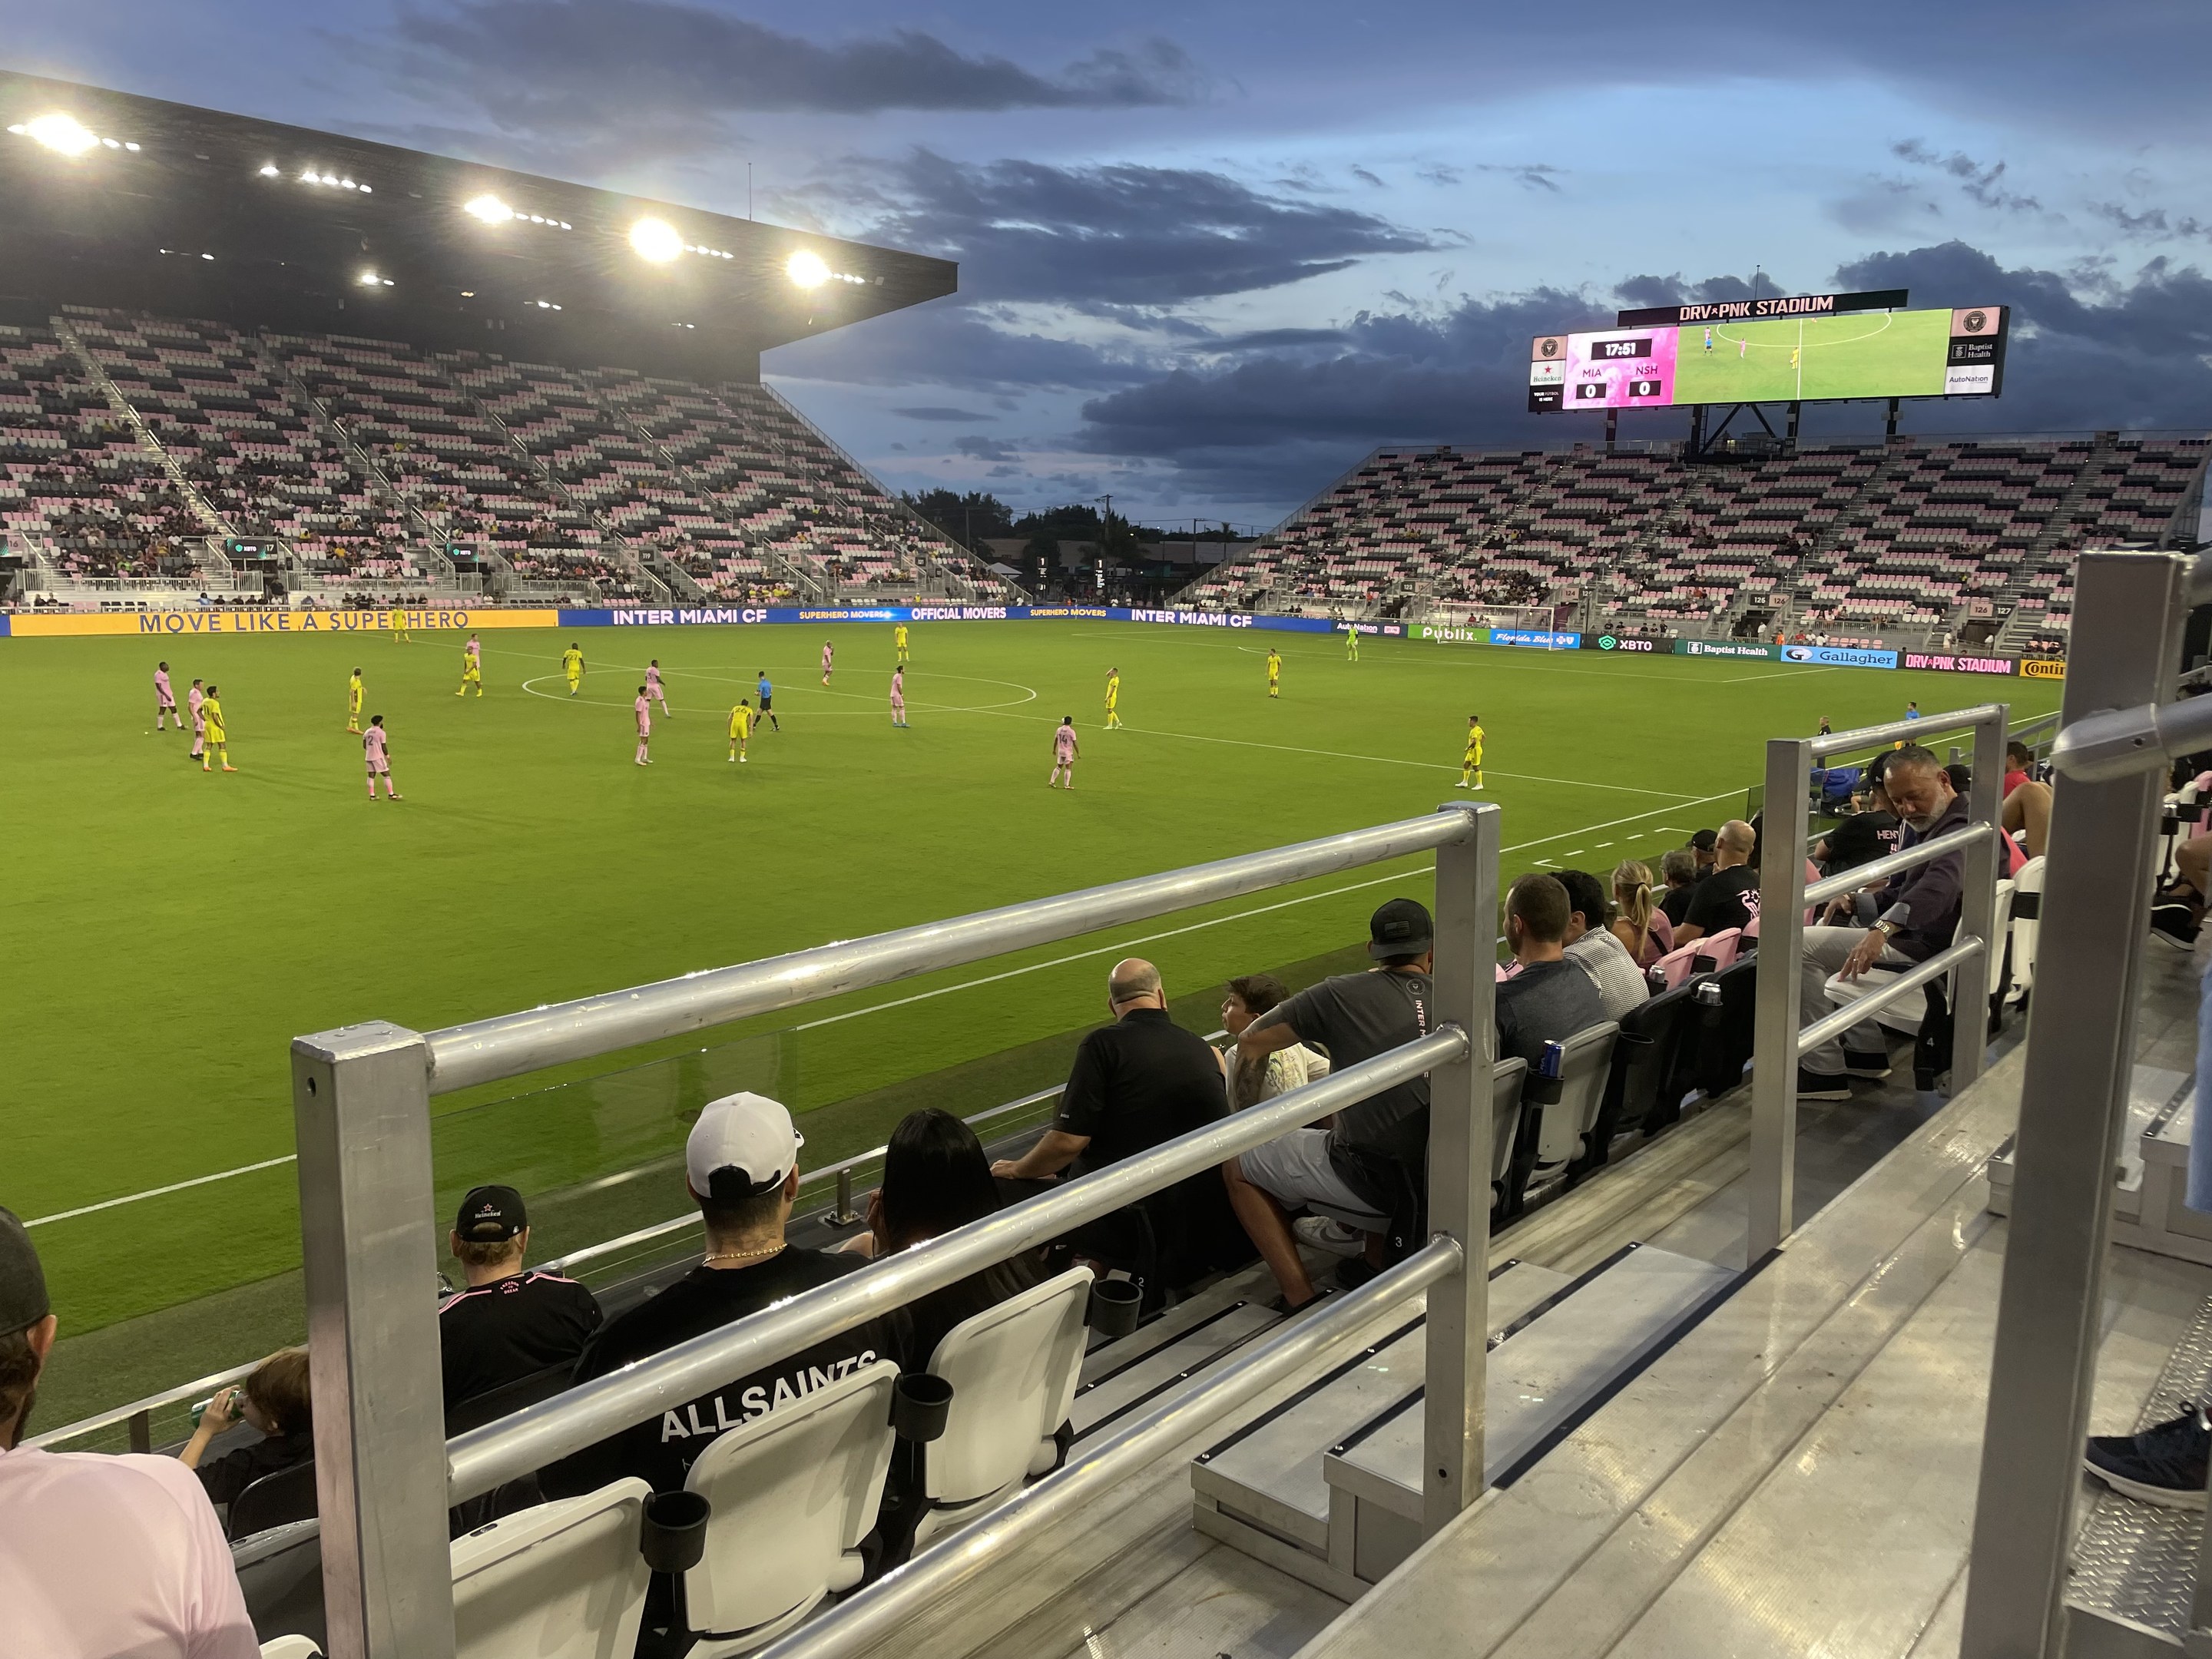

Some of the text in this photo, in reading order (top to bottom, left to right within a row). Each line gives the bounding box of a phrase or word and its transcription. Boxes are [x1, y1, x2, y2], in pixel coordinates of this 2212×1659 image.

[1757, 296, 1833, 315] STADIUM
[1605, 343, 1636, 356] 17:51
[1582, 369, 1601, 377] MIA
[1636, 366, 1657, 375] NSH
[1585, 385, 1596, 399] 0
[1639, 382, 1651, 396] 0
[614, 609, 767, 625] INTER MIAMI CF
[799, 611, 849, 619] SUPERHERO
[911, 607, 1006, 620] OFFICIAL MOVERS
[1131, 609, 1252, 628] INTER MIAMI CF
[140, 611, 469, 632] MOVE LIKE A SUPEHERO
[1337, 623, 1377, 631] AutNation
[1496, 633, 1531, 643] Florida
[1620, 640, 1652, 651] XBTO
[1704, 645, 1768, 656] Baptist Health
[1820, 651, 1893, 665] Gallagher
[1958, 658, 2012, 674] STADIUM
[1059, 733, 1067, 744] 14
[1415, 1000, 1426, 1027] INTER
[475, 1210, 502, 1219] Heineken
[1396, 1237, 1402, 1247] 3
[1138, 1277, 1144, 1287] 2
[661, 1349, 876, 1442] ALLSAINTS
